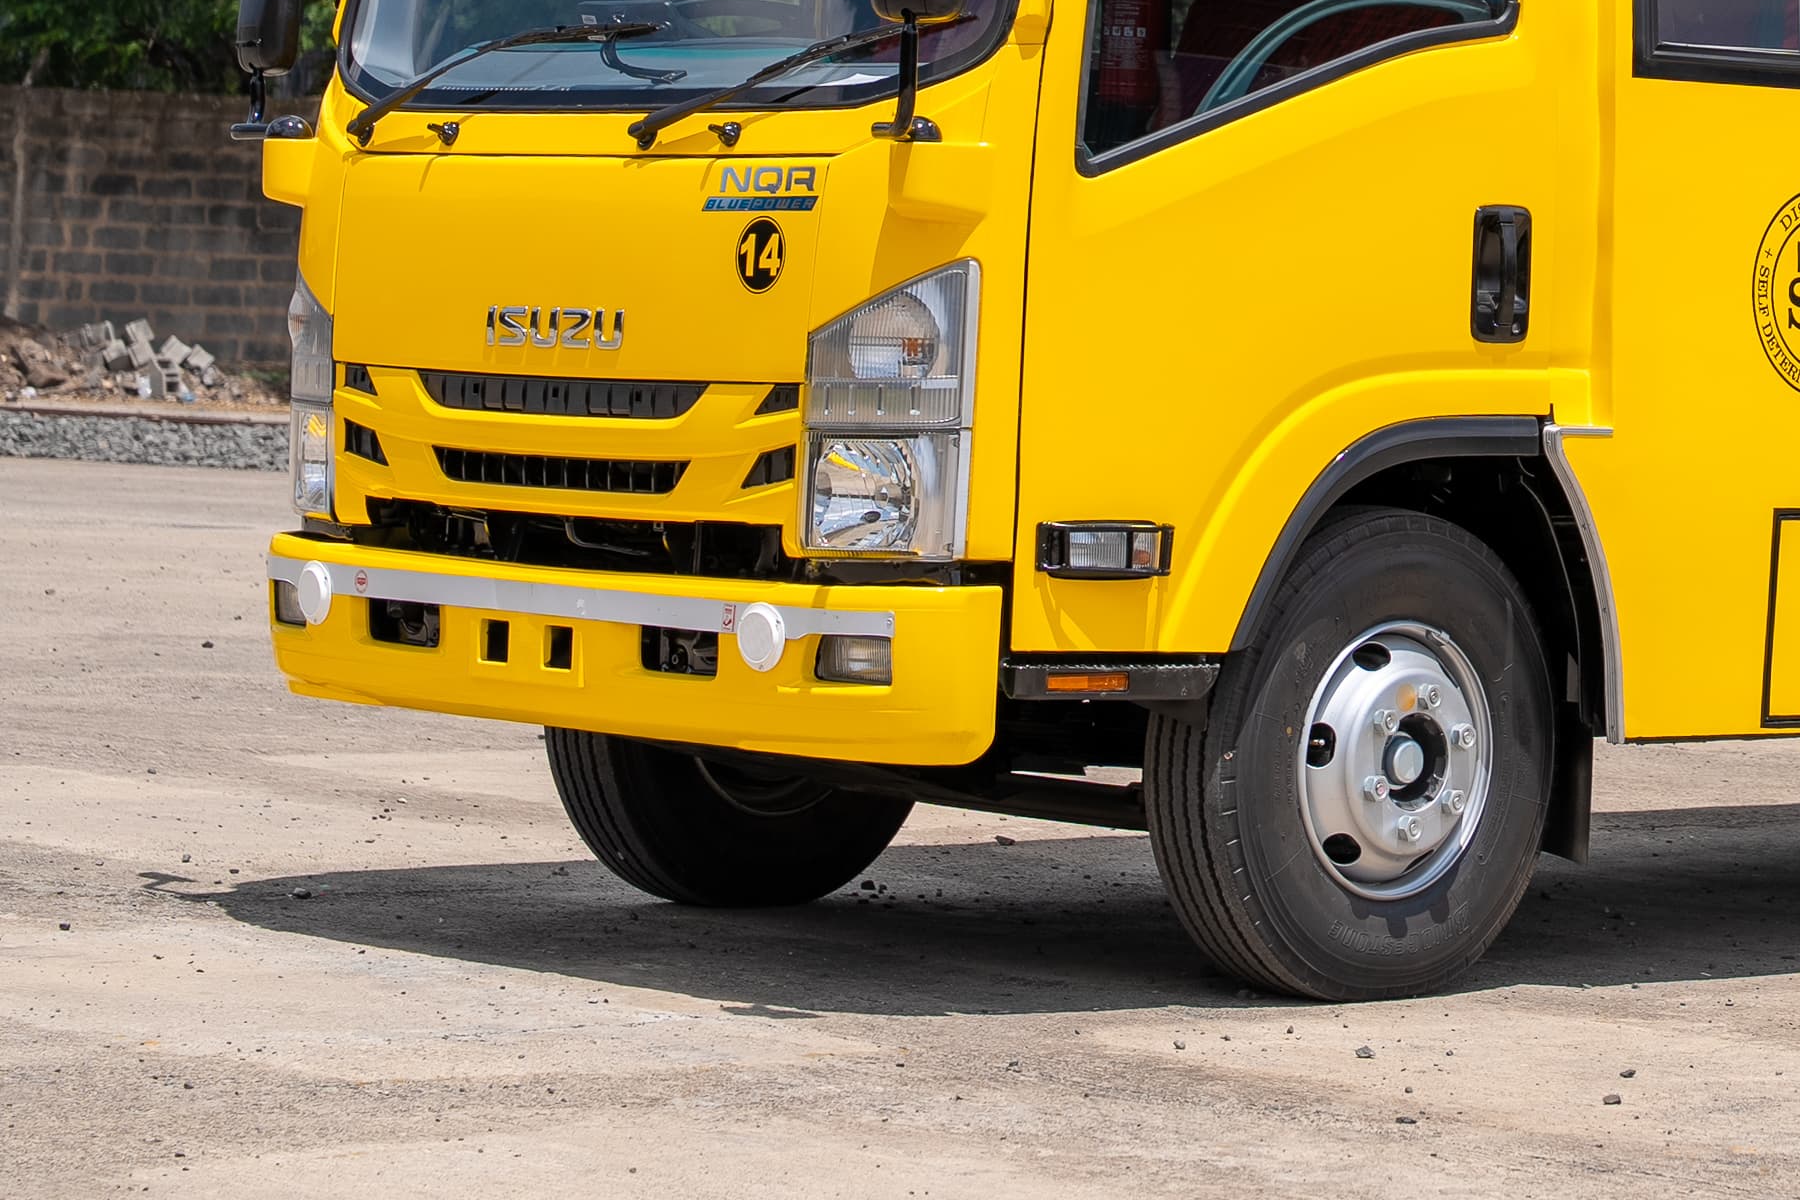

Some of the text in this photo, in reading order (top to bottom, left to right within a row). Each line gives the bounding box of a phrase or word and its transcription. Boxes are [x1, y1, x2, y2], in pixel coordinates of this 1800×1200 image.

[719, 166, 816, 194] NQR
[739, 233, 781, 277] 14
[1757, 265, 1770, 318] SELF
[486, 305, 625, 350] ISUZU
